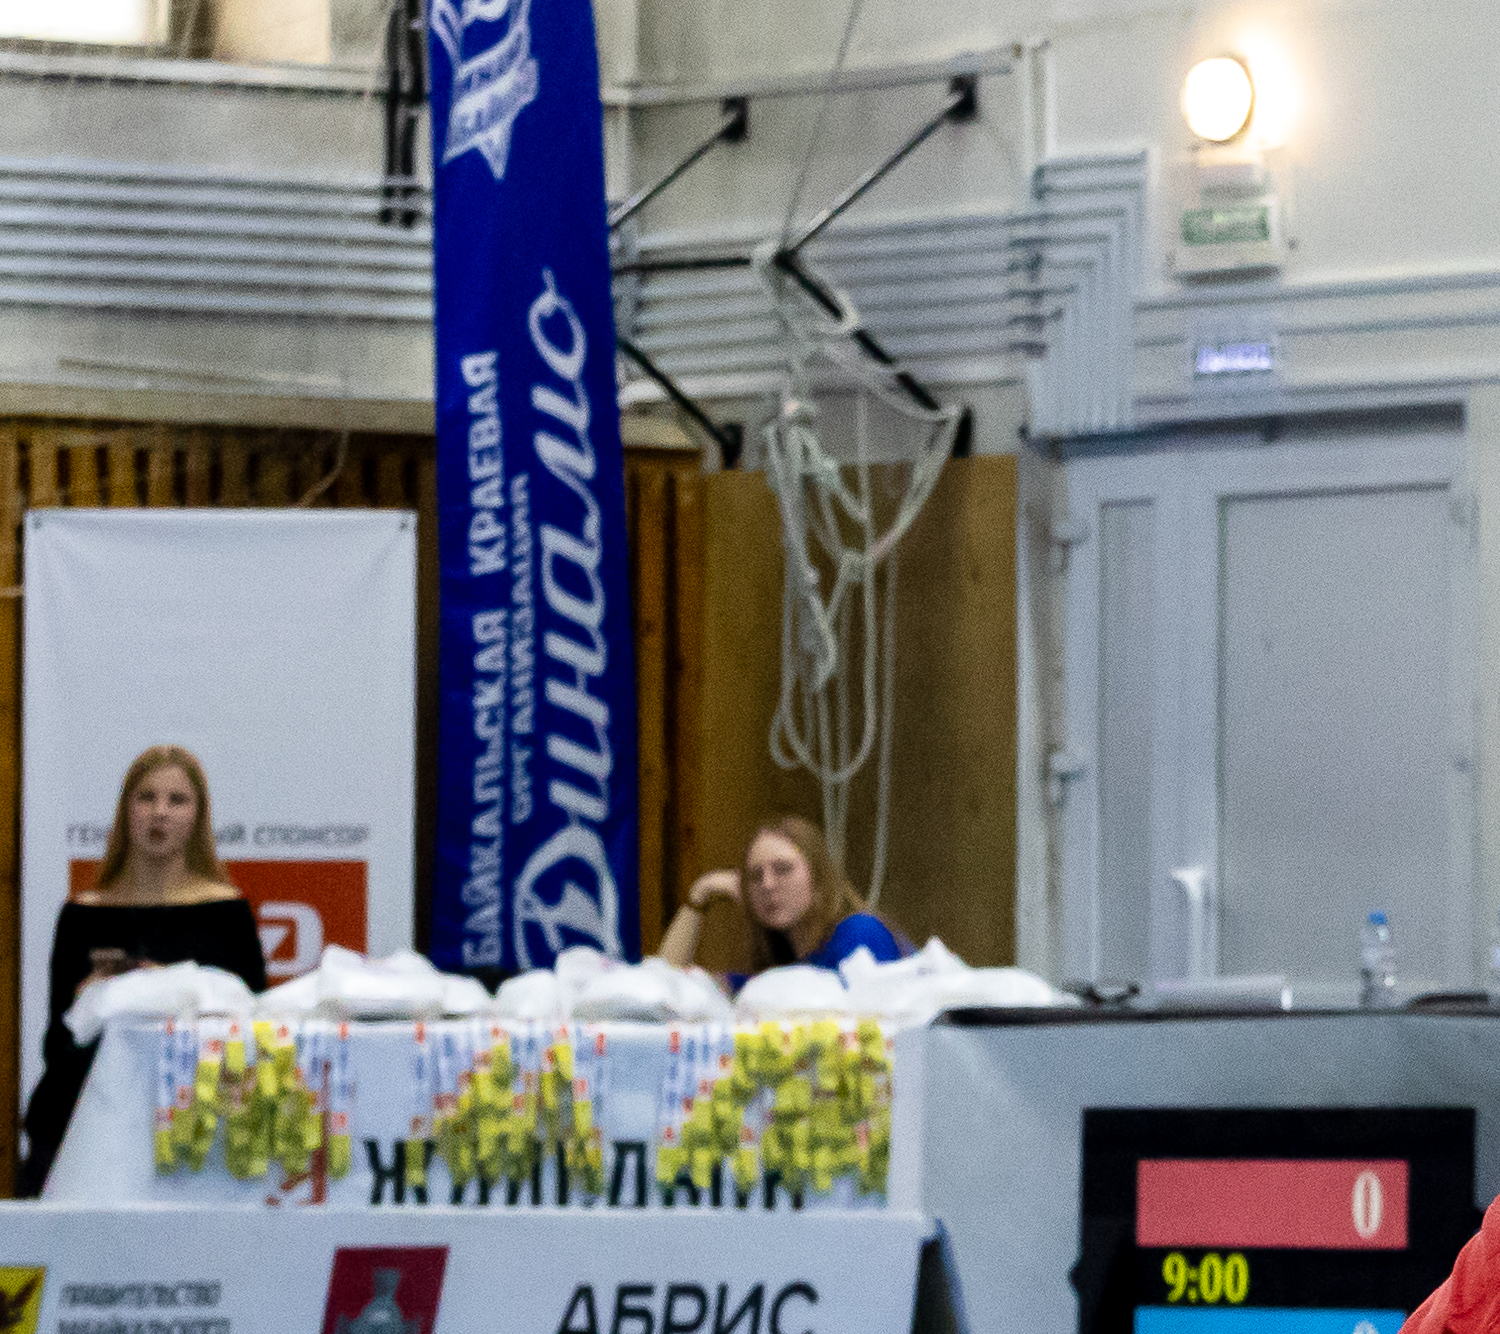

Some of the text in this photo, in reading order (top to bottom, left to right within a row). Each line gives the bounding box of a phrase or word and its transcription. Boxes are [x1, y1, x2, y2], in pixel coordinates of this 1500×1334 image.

[461, 350, 506, 966] БАЙКАЛЬСКАЯ КРАЕВАЯ
[1351, 1170, 1384, 1240] 0
[1161, 1251, 1250, 1304] 9:00
